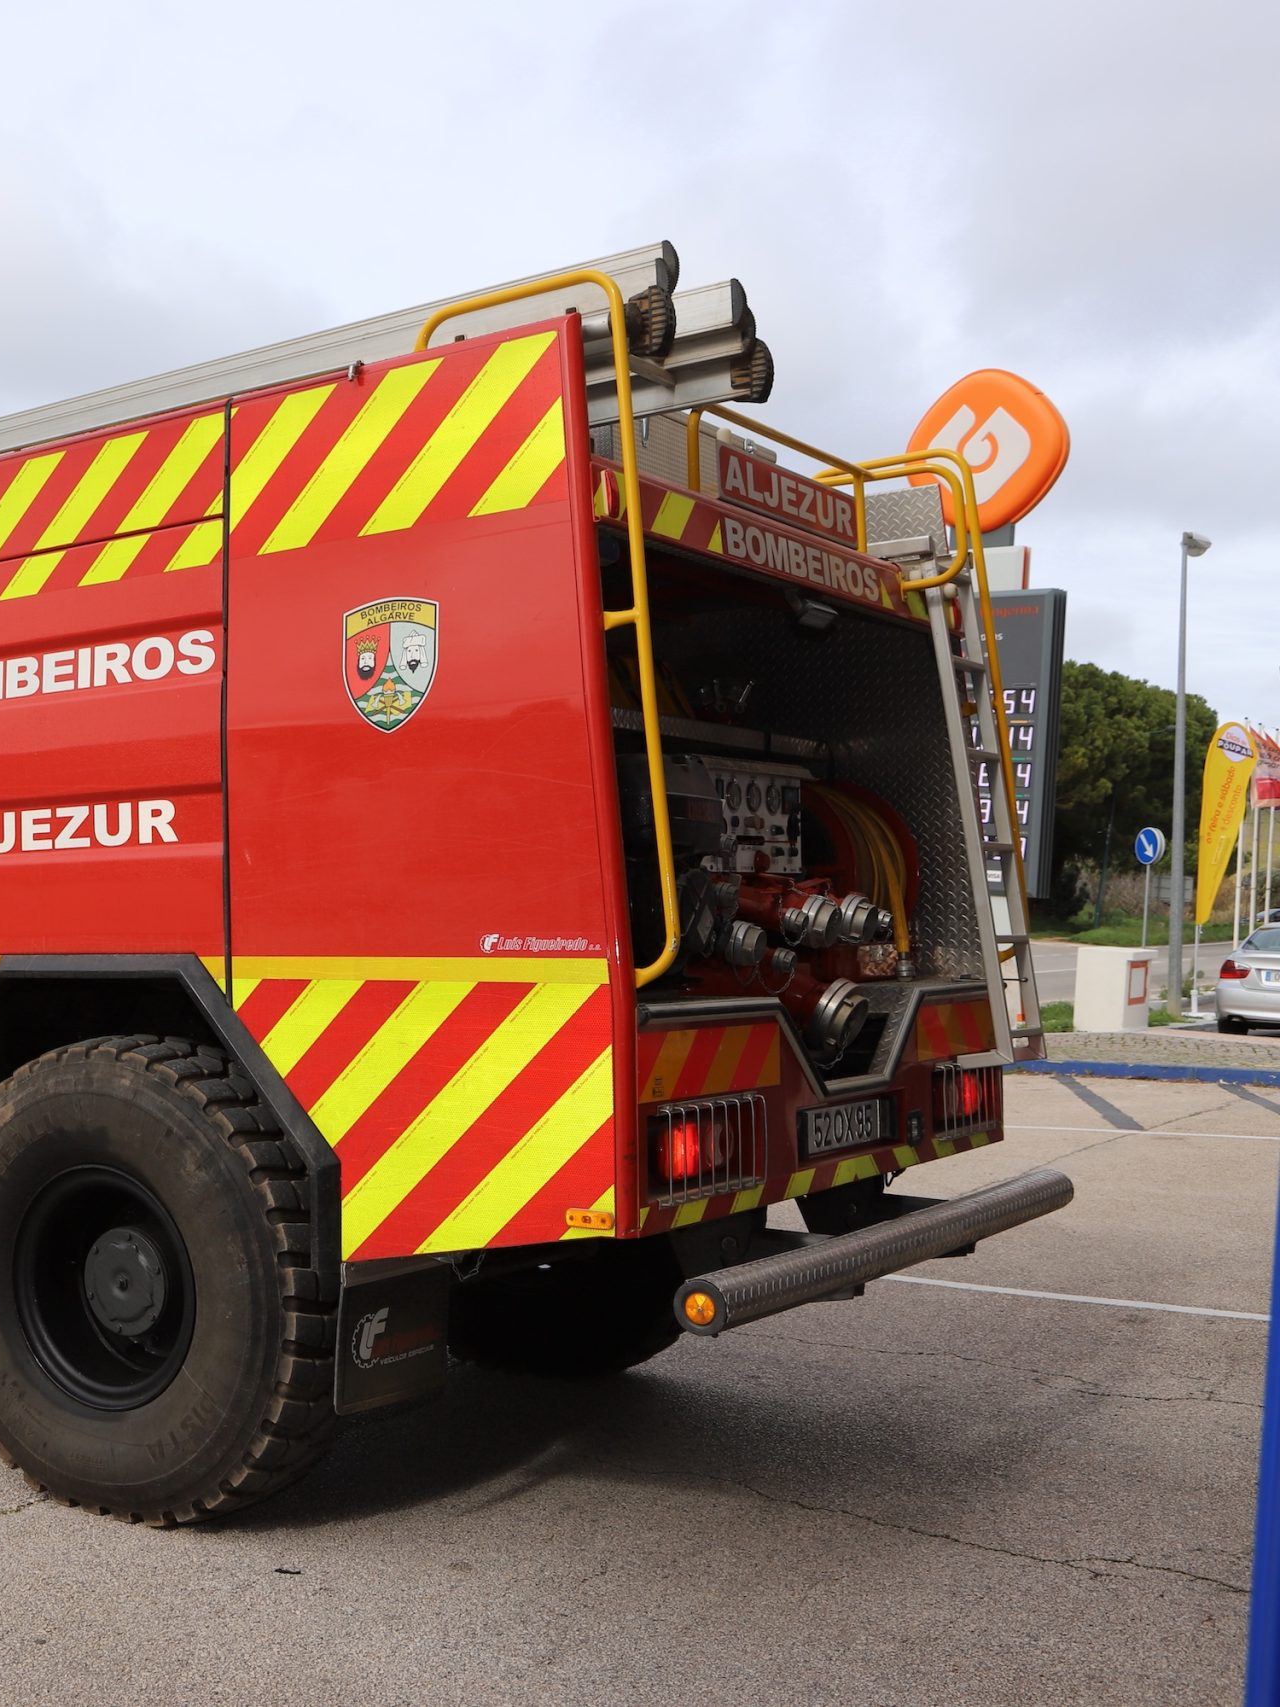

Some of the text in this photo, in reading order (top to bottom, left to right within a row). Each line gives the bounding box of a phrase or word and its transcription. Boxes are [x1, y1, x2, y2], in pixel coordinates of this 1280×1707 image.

[725, 455, 854, 538] ALJEZUR
[724, 517, 880, 602] BOMBEIROS
[360, 602, 422, 620] BOMBEIROS
[367, 611, 415, 626] ALGARVE
[523, 936, 589, 952] Figueiredo
